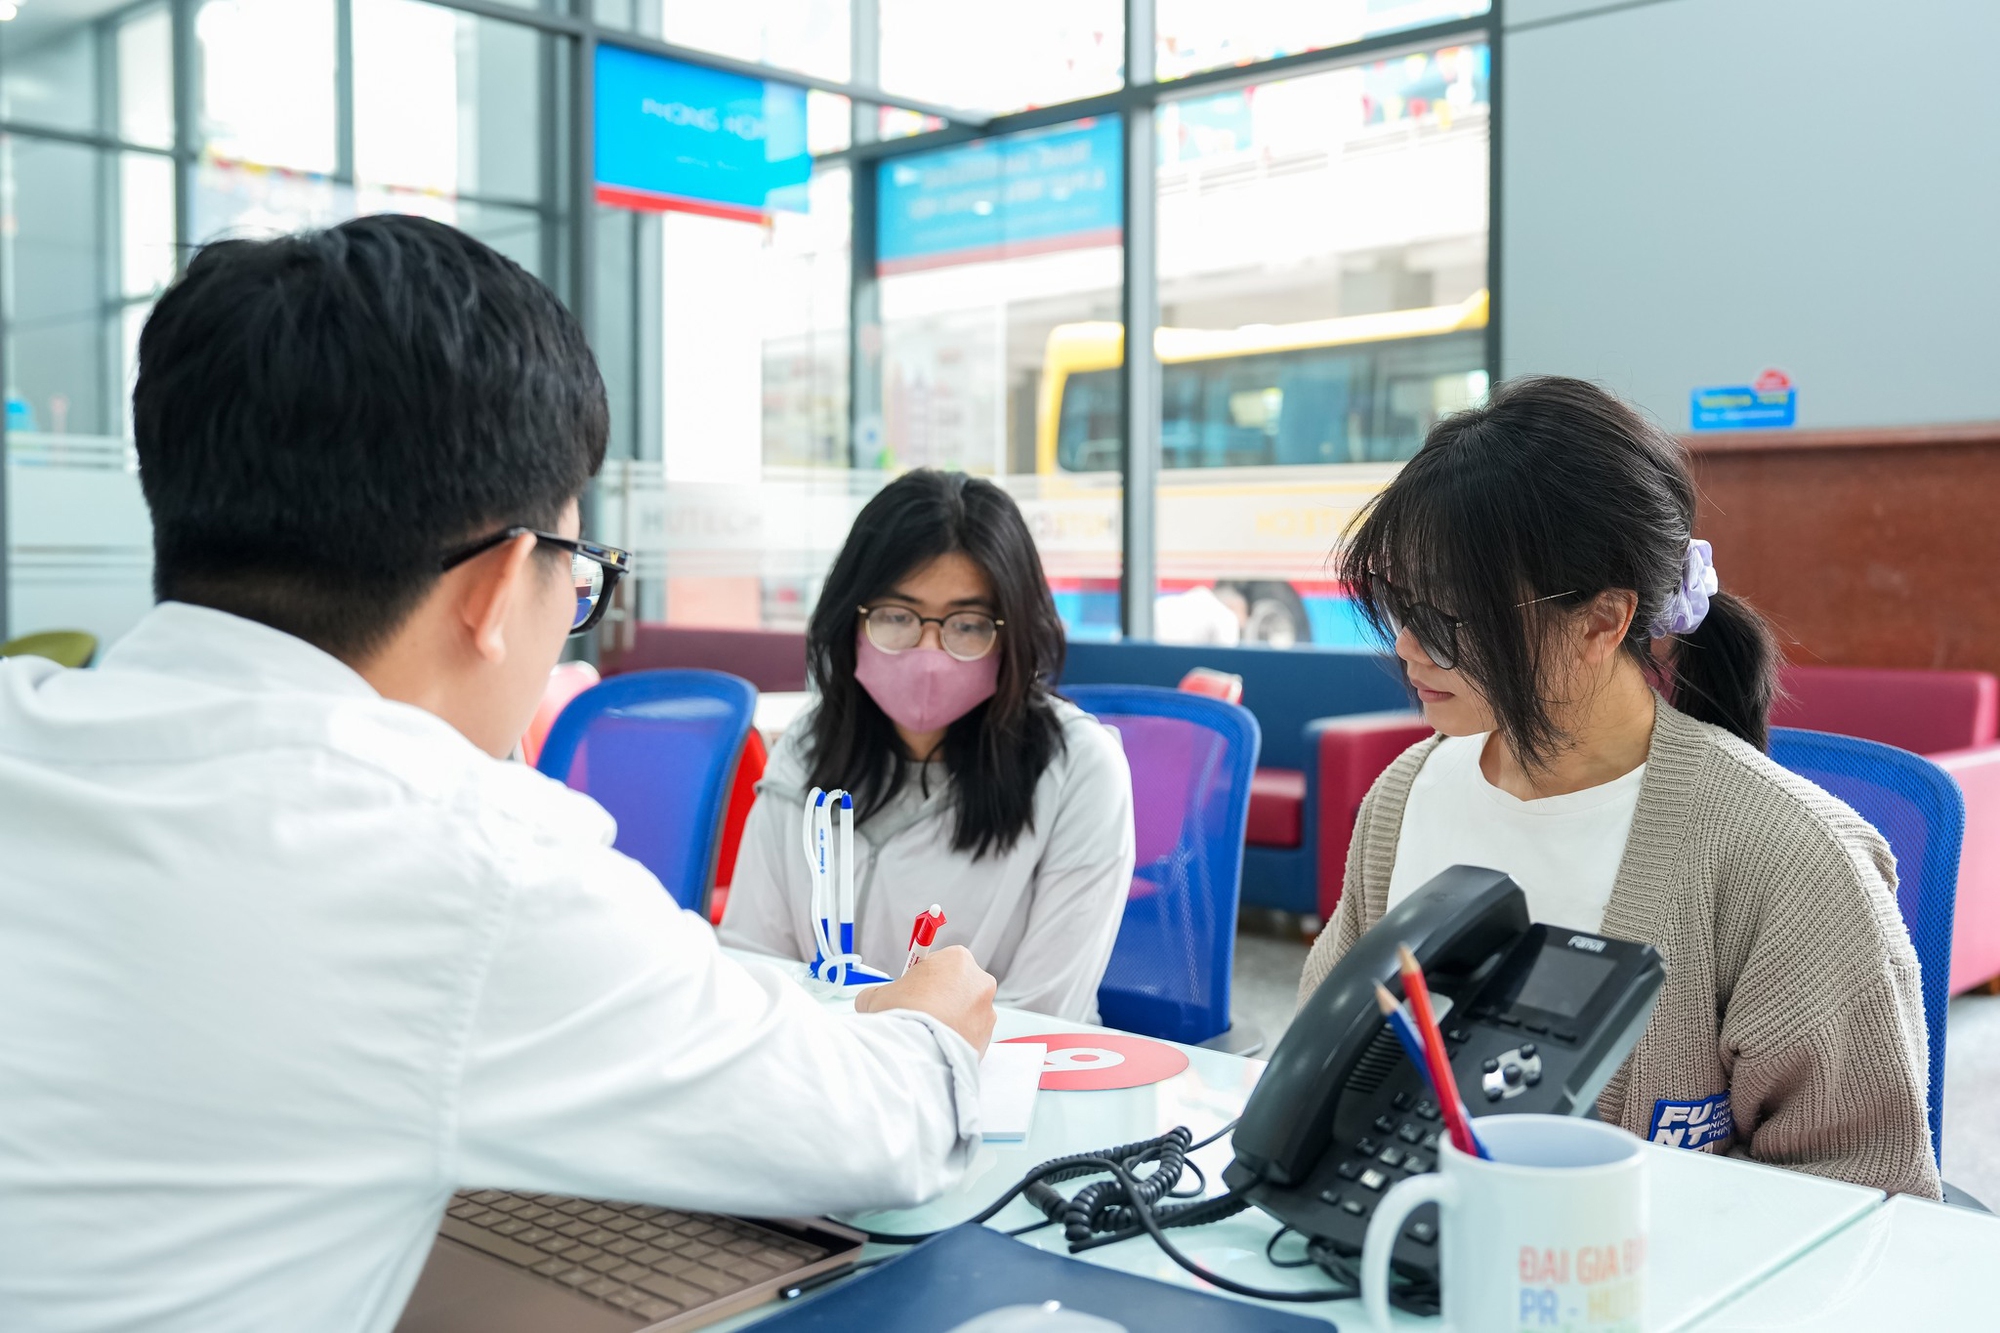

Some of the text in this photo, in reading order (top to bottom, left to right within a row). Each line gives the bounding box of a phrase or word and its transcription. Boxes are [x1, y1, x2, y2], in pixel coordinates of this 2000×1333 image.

[1657, 1101, 1714, 1128] FU
[1653, 1123, 1710, 1147] NT
[1519, 1287, 1558, 1324] PR
